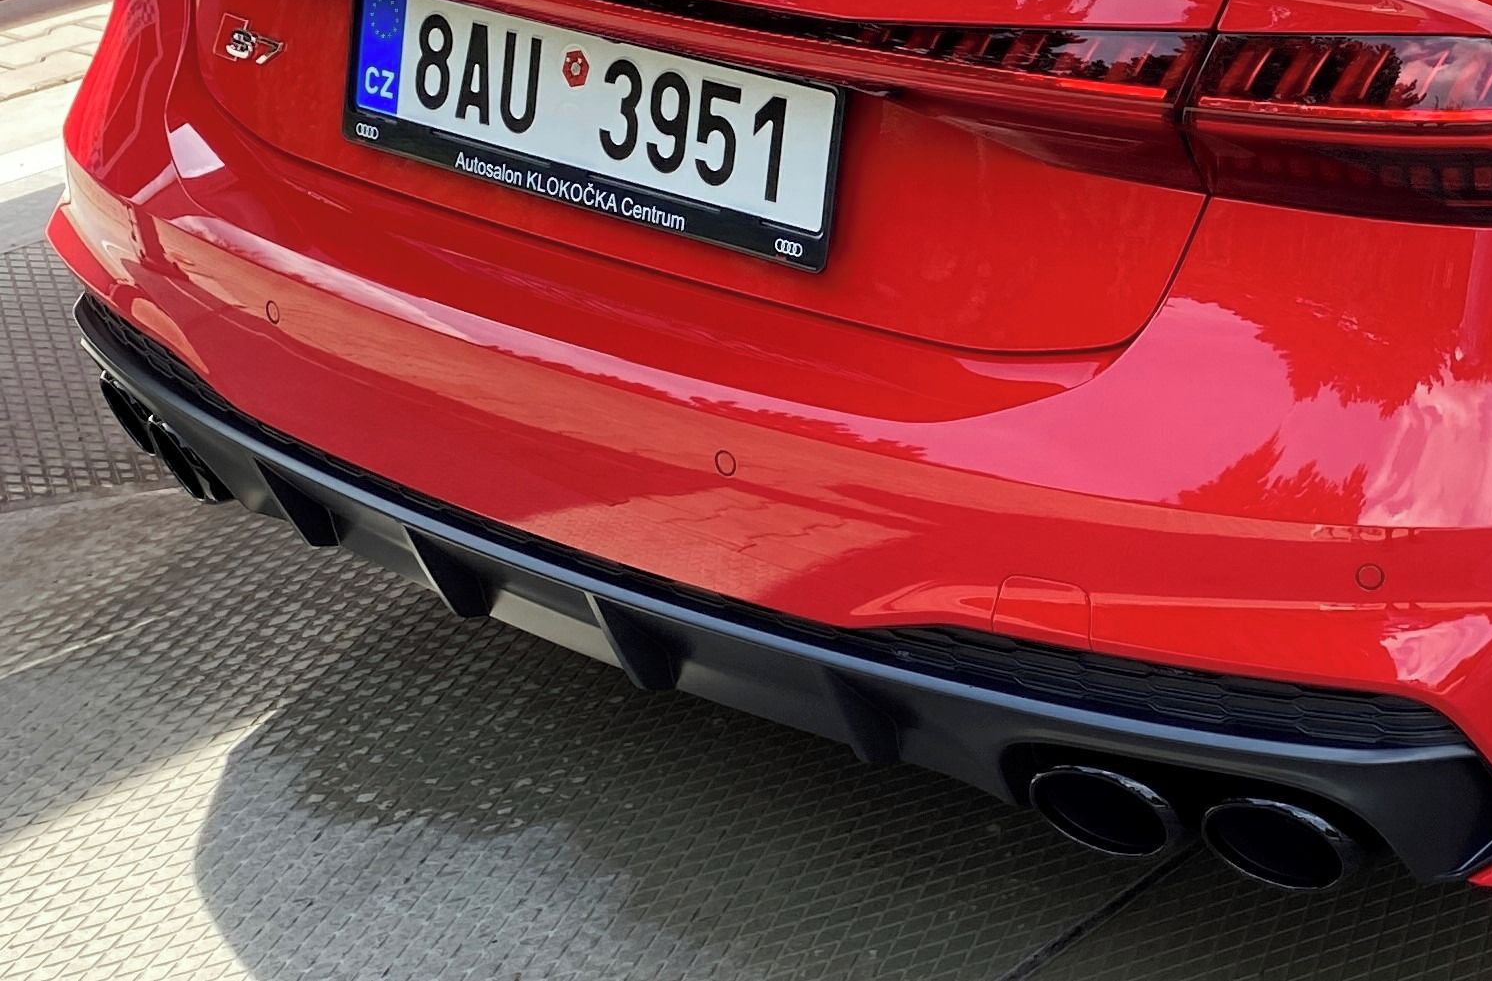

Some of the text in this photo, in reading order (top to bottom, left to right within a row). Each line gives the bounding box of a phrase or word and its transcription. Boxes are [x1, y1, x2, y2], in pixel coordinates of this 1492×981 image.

[364, 65, 394, 100] CZ
[415, 13, 788, 203] 8AU 3951
[454, 151, 686, 232] Autosalon KLOKOČKA Centrum
